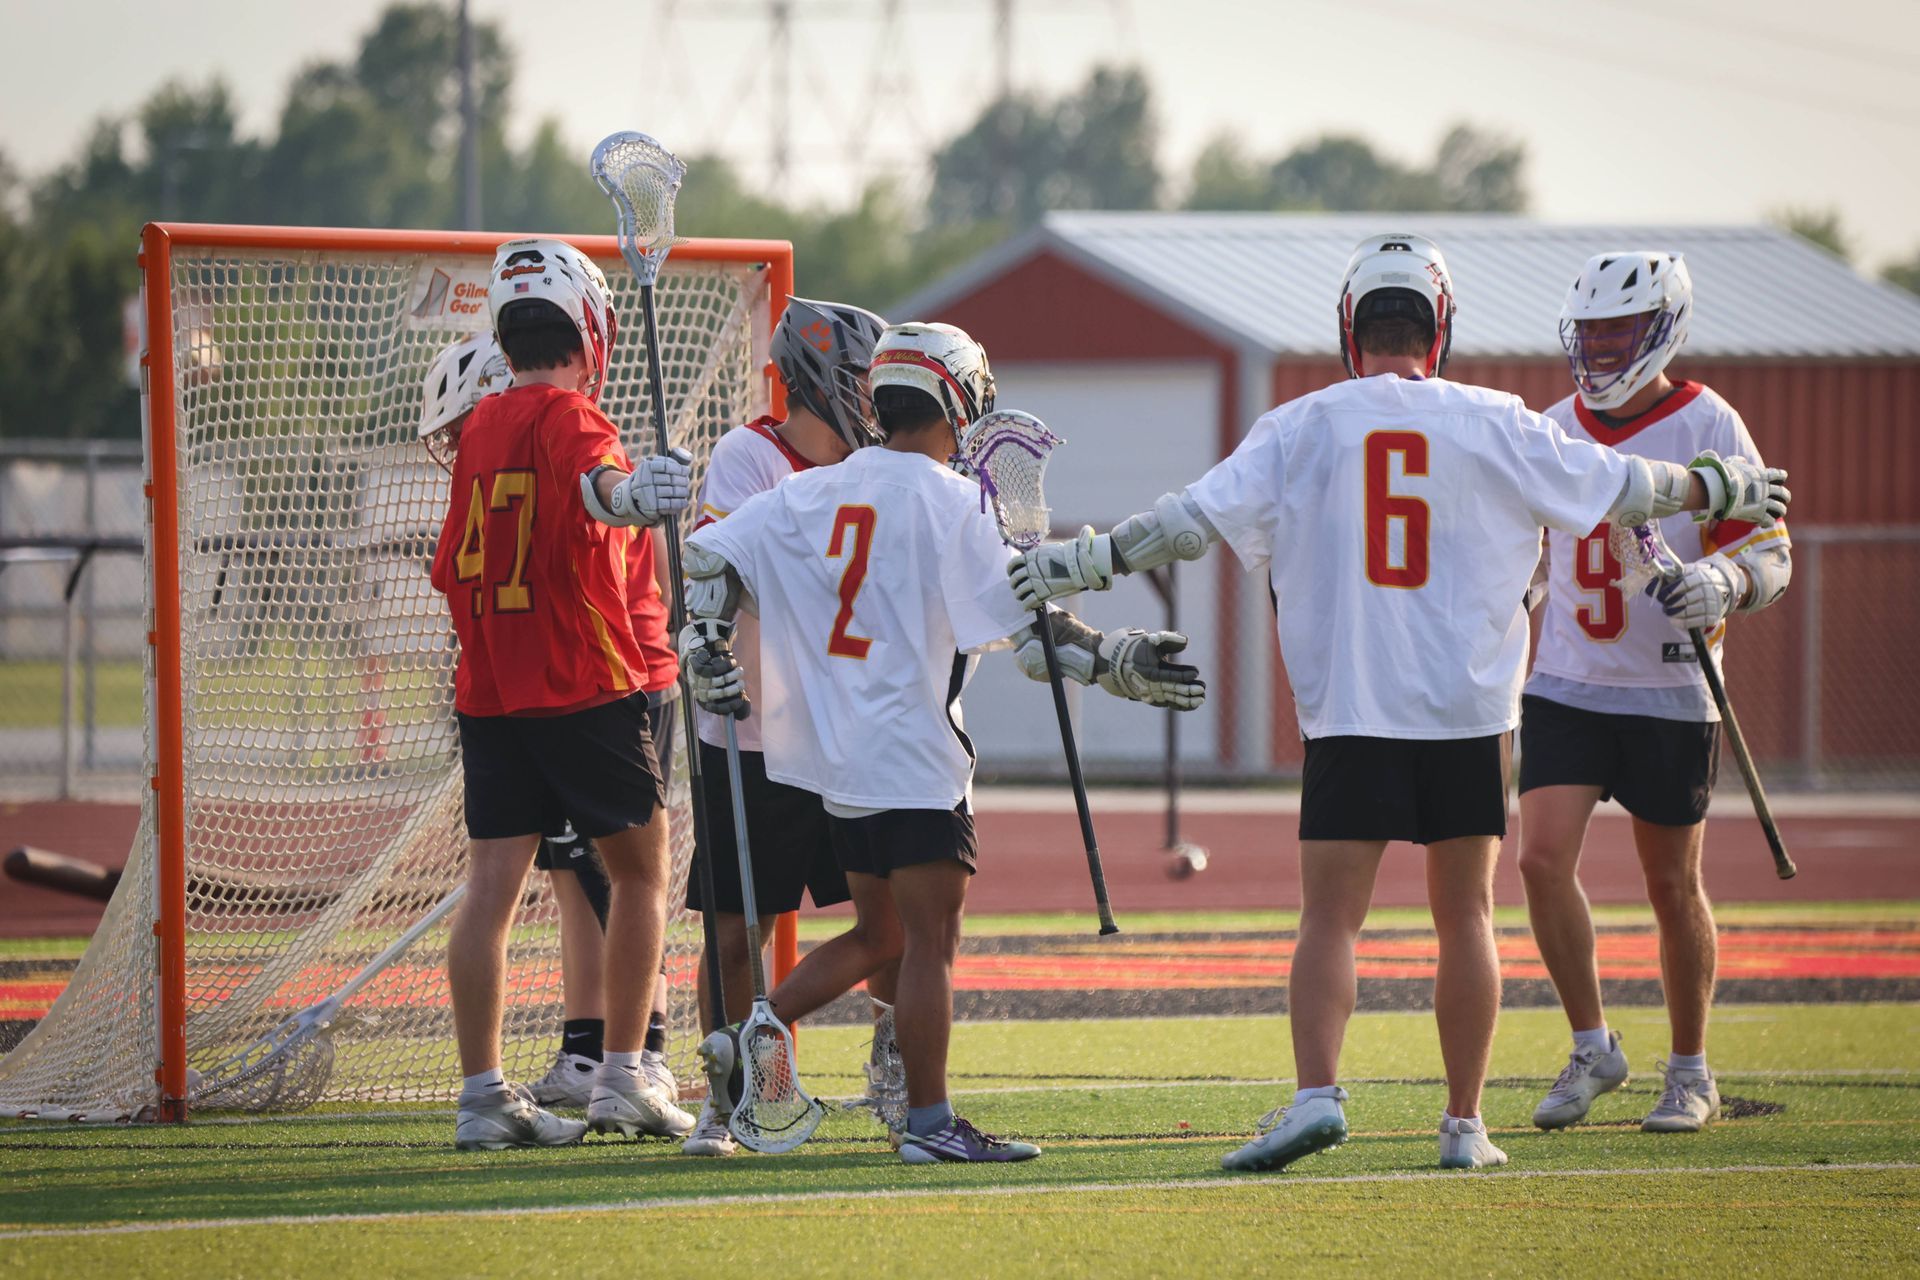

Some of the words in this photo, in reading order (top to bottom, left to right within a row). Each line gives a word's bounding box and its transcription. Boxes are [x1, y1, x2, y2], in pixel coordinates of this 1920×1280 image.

[450, 299, 482, 314] Gear
[543, 277, 552, 286] 42
[1364, 429, 1430, 590] 6
[825, 504, 877, 660] 2
[1573, 519, 1629, 644] 9
